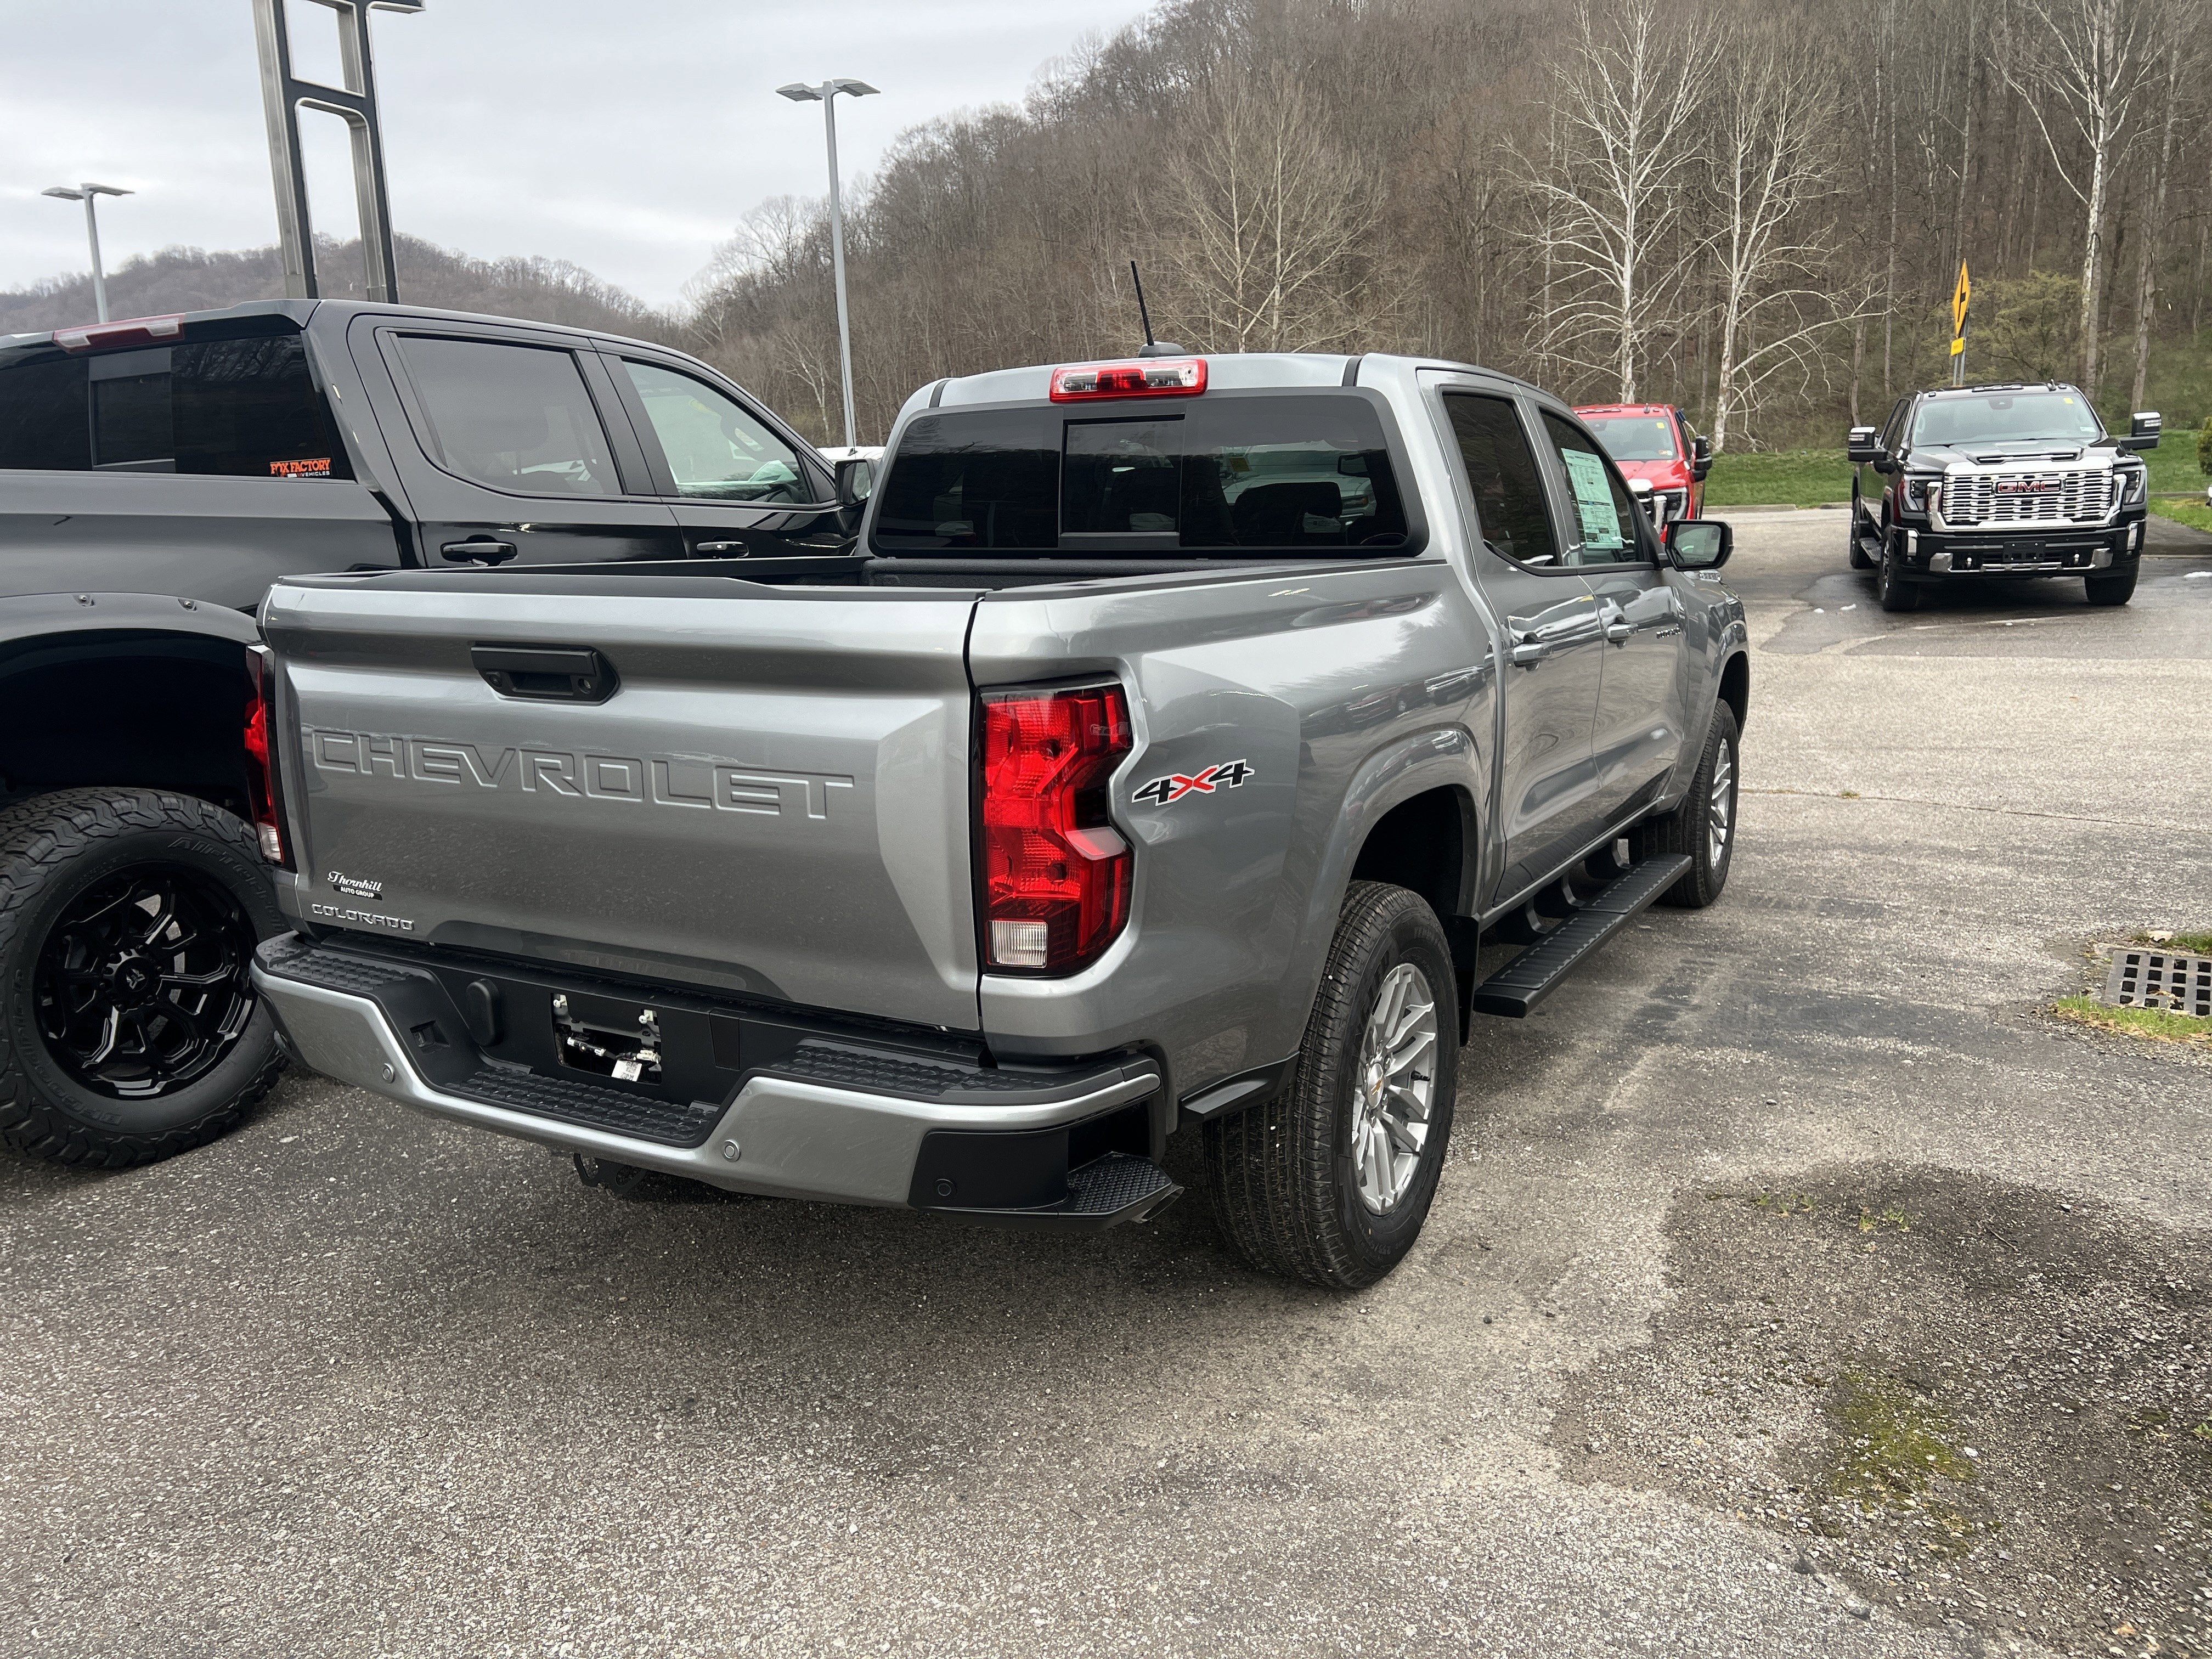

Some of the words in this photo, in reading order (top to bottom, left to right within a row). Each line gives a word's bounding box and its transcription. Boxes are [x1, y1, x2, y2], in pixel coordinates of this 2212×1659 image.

[290, 459, 330, 473] FACTORY
[1997, 479, 2061, 494] GMC
[311, 728, 855, 819] CHEVROLET
[327, 871, 382, 892] Thornhill
[340, 886, 355, 895] AUTO
[355, 889, 375, 899] GROUP
[311, 904, 415, 931] COLORADO
